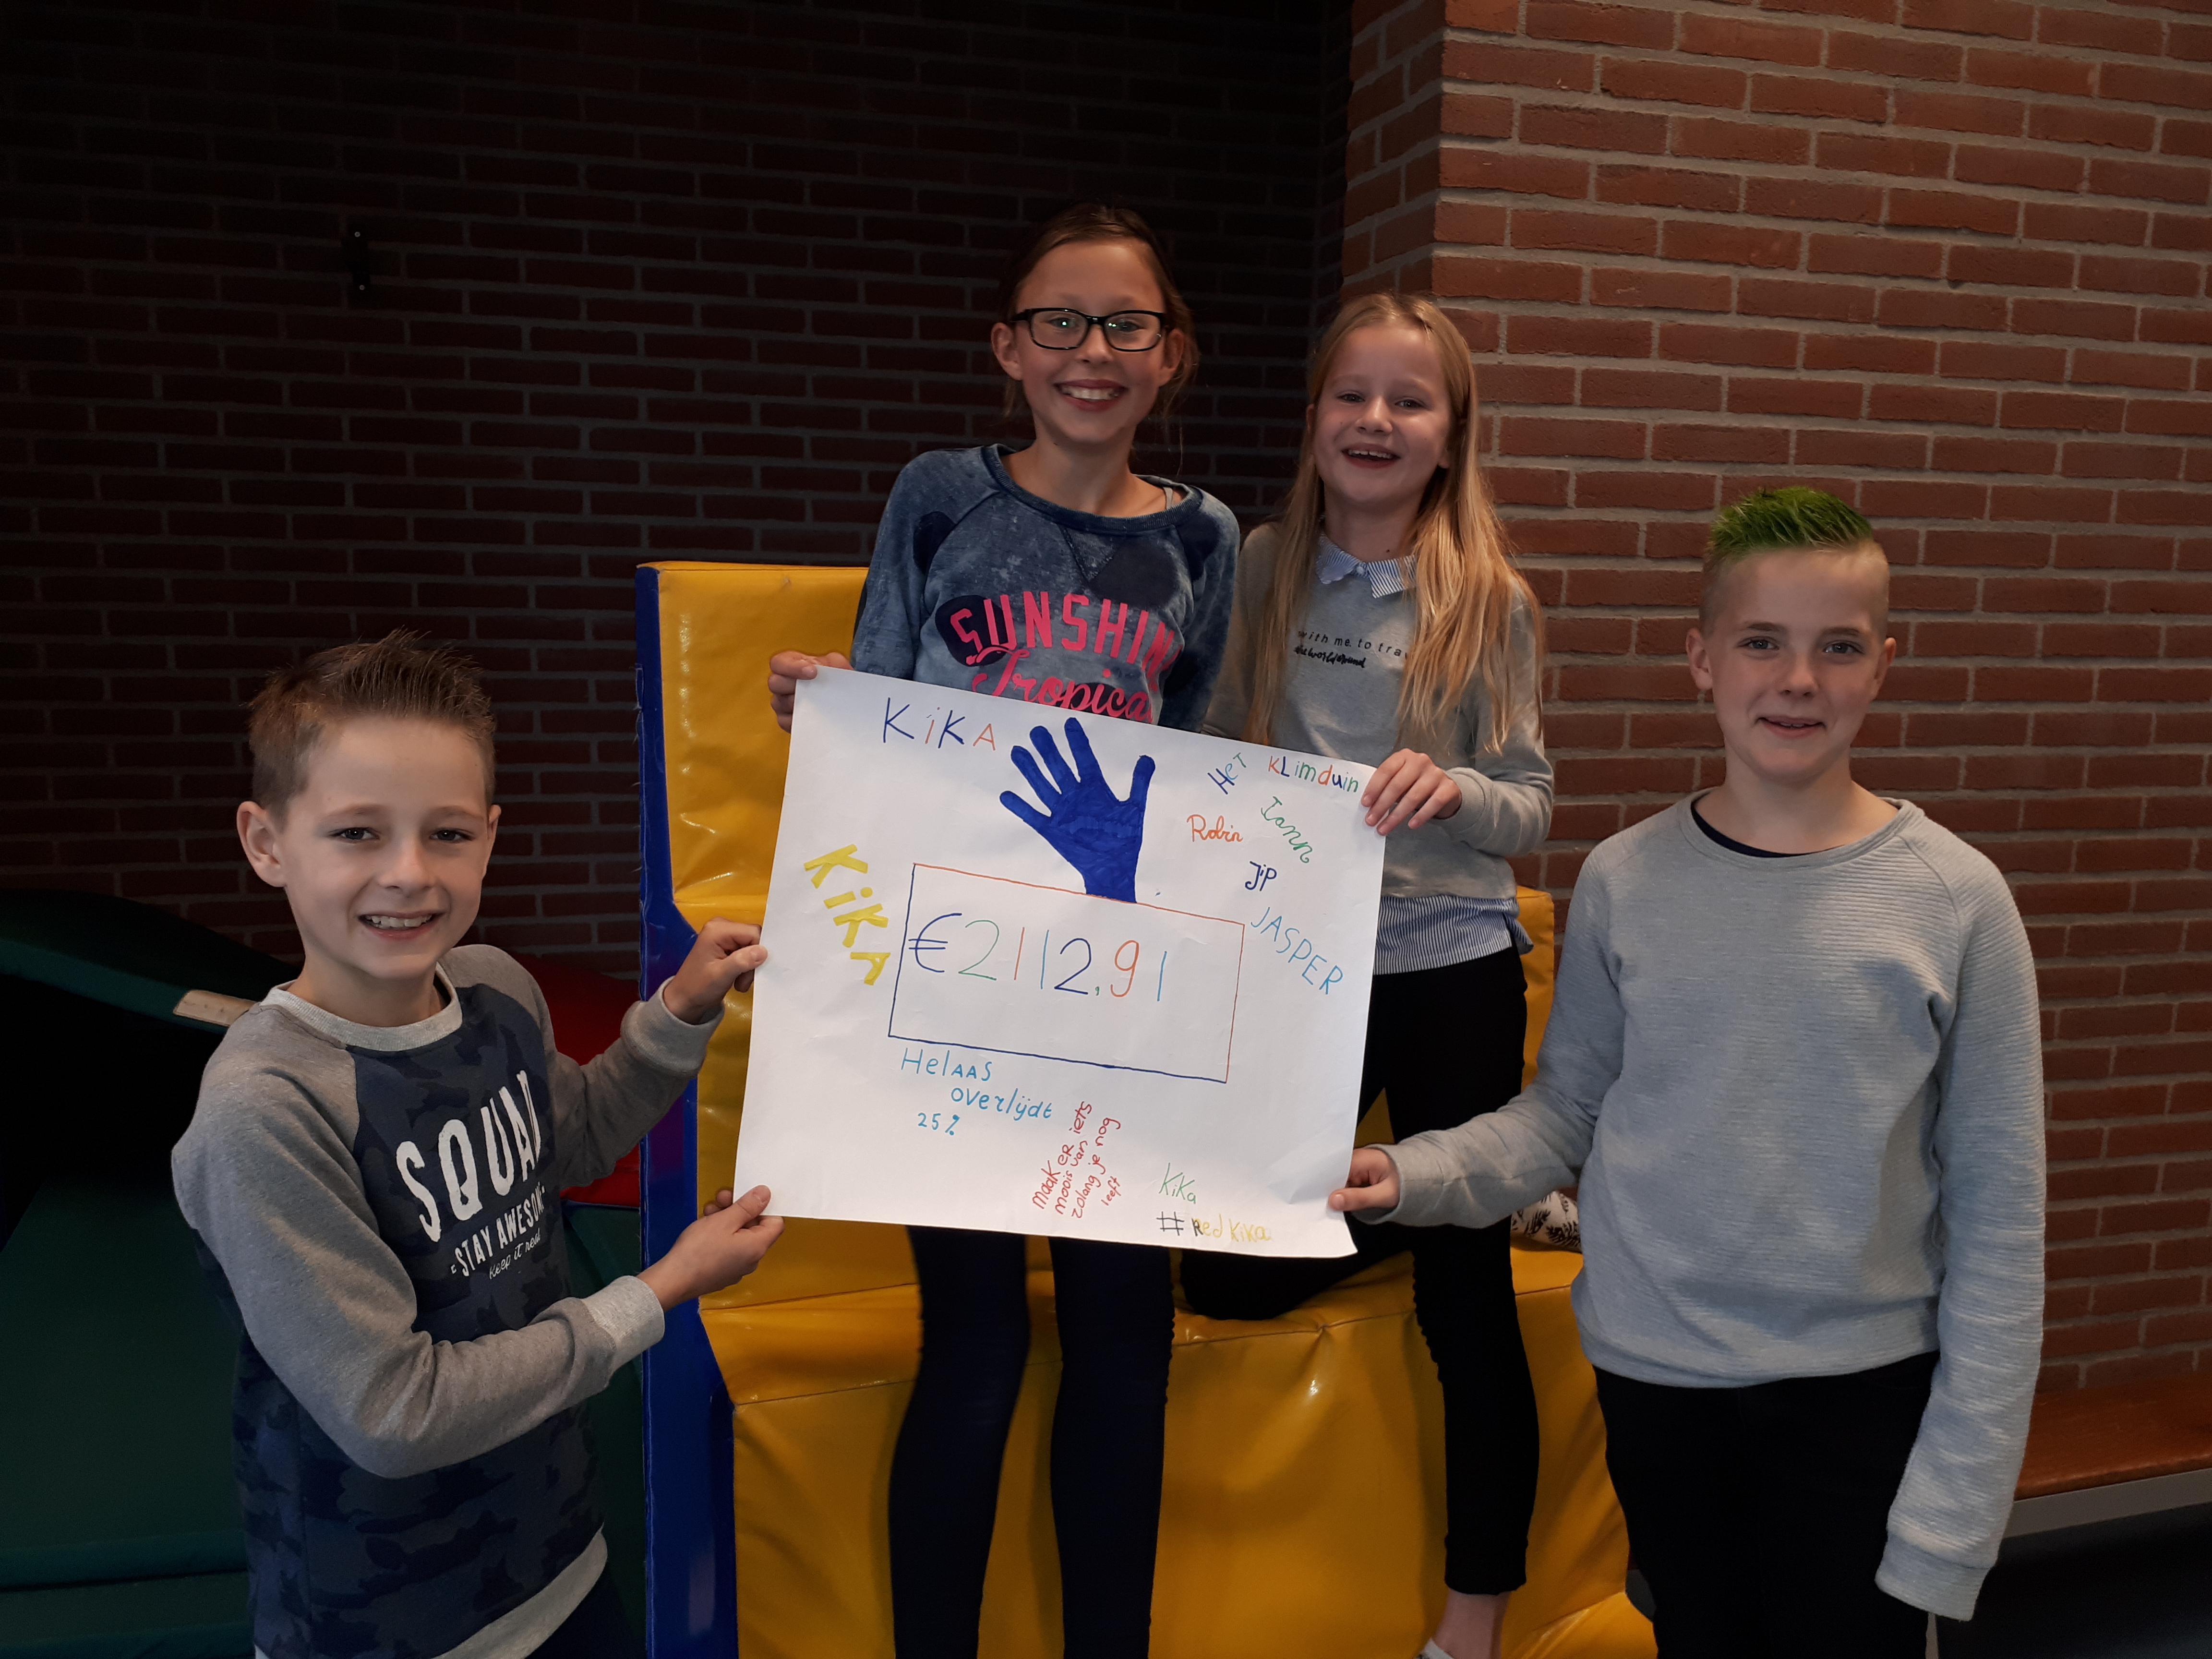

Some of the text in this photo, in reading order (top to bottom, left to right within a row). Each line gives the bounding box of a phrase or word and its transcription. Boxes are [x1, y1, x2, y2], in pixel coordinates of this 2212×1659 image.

[1298, 630, 1328, 644] with
[1358, 638, 1372, 649] to
[972, 644, 1153, 723] Tropica
[883, 697, 996, 751] KiKA
[1186, 814, 1244, 843] Robin
[1250, 906, 1344, 995] JASPER
[1069, 1101, 1092, 1134] iets
[1055, 1140, 1088, 1215] moois van
[1071, 1117, 1121, 1218] zolang je nog
[1101, 1176, 1121, 1206] leeft
[455, 1225, 493, 1277] STAY
